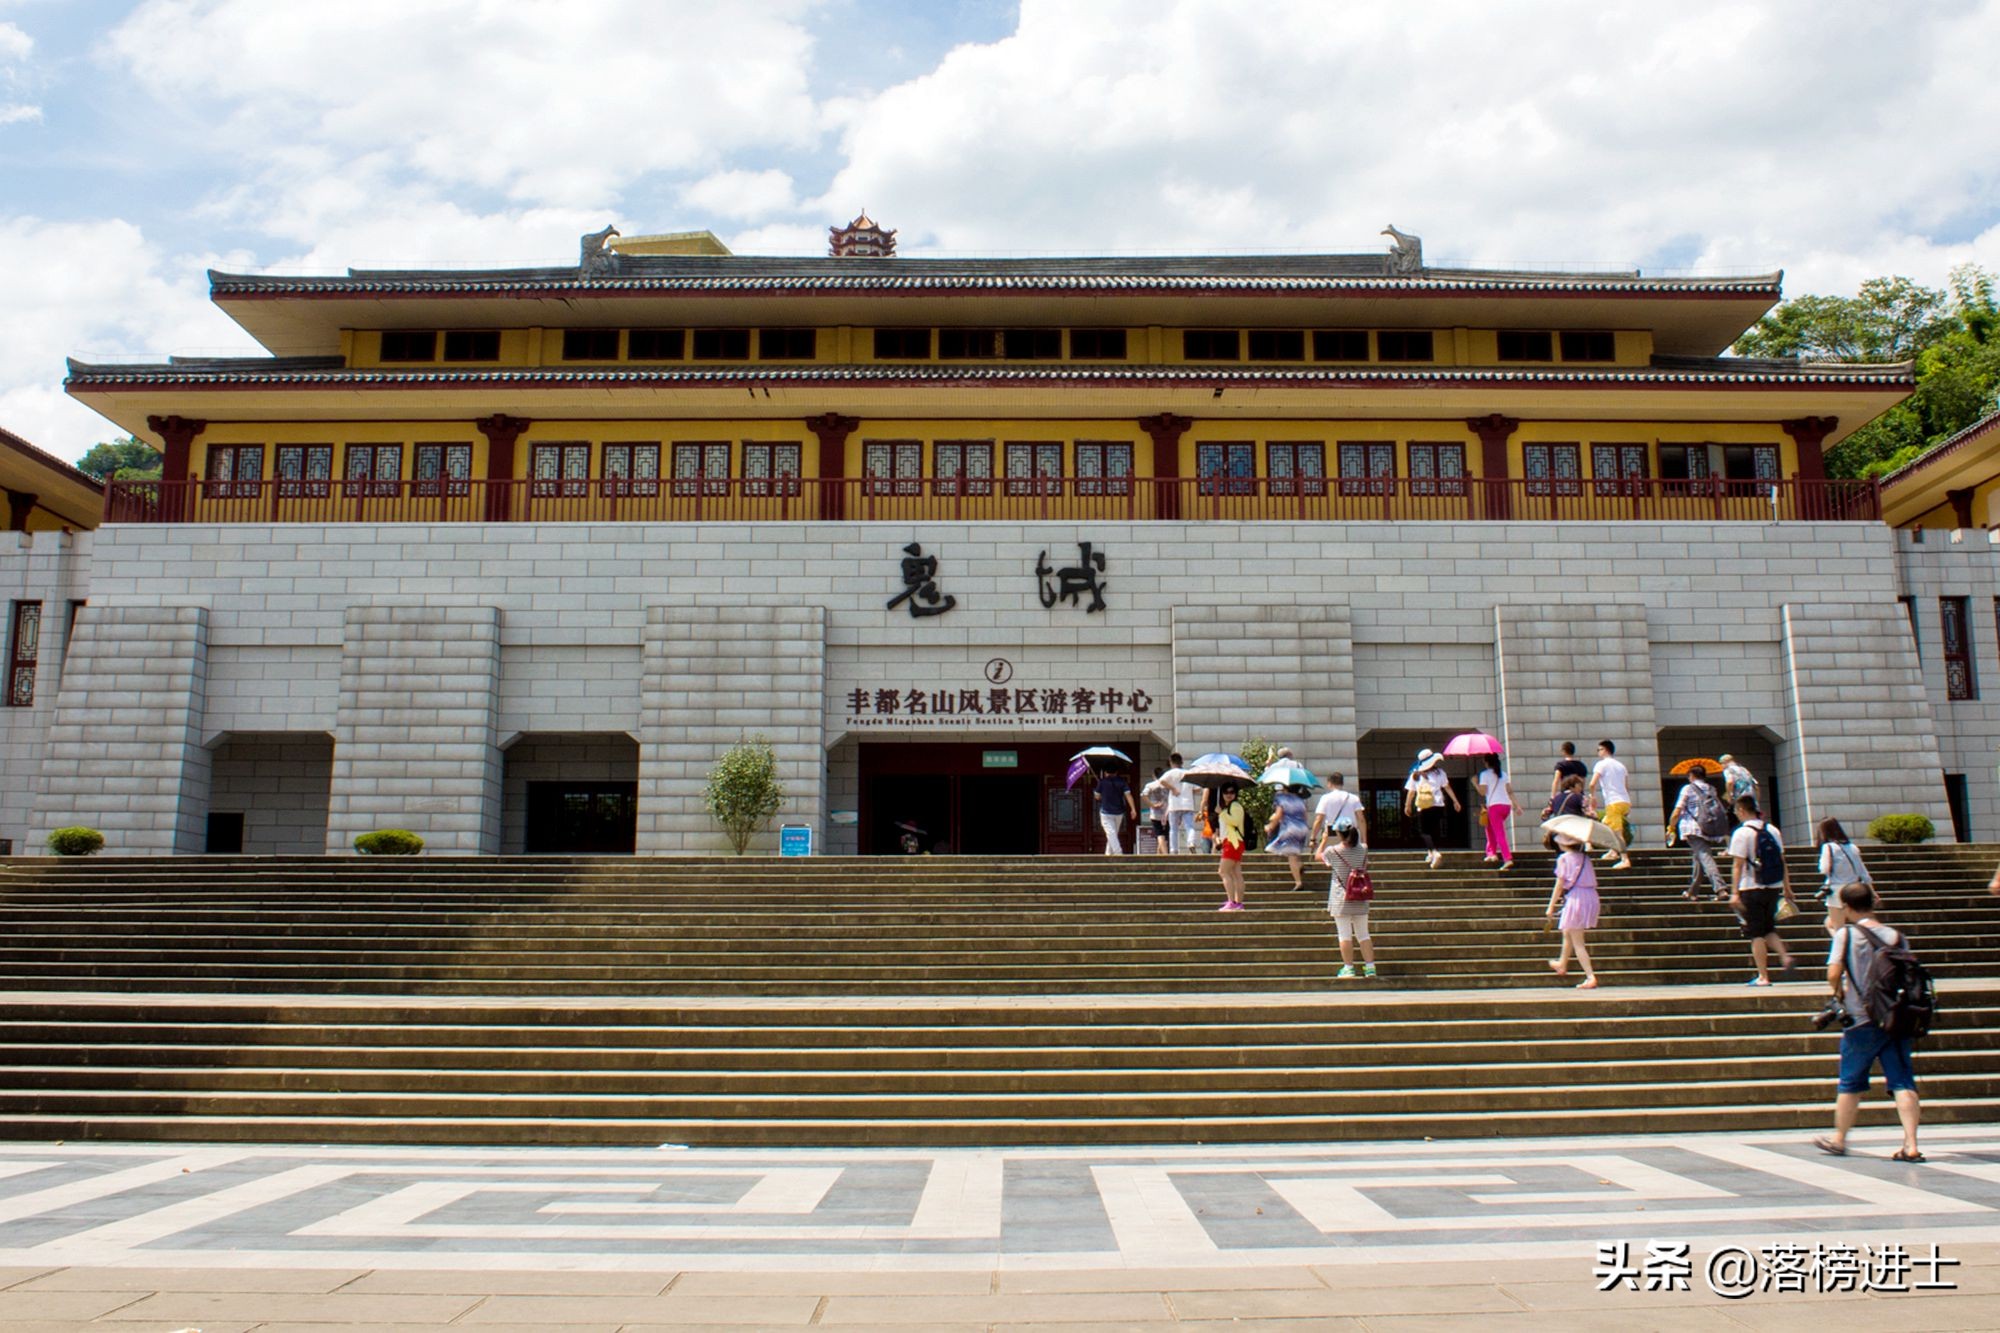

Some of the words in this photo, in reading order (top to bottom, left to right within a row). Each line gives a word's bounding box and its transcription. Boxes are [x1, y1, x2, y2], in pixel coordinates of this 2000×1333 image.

[847, 687, 1153, 715] 丰都名山风景区游客中心
[886, 717, 934, 726] Mingshan
[939, 717, 971, 725] Scenic
[975, 717, 1014, 725] Section
[1018, 717, 1057, 725] Tourist
[1062, 717, 1113, 725] Reception
[1116, 717, 1153, 725] Centre
